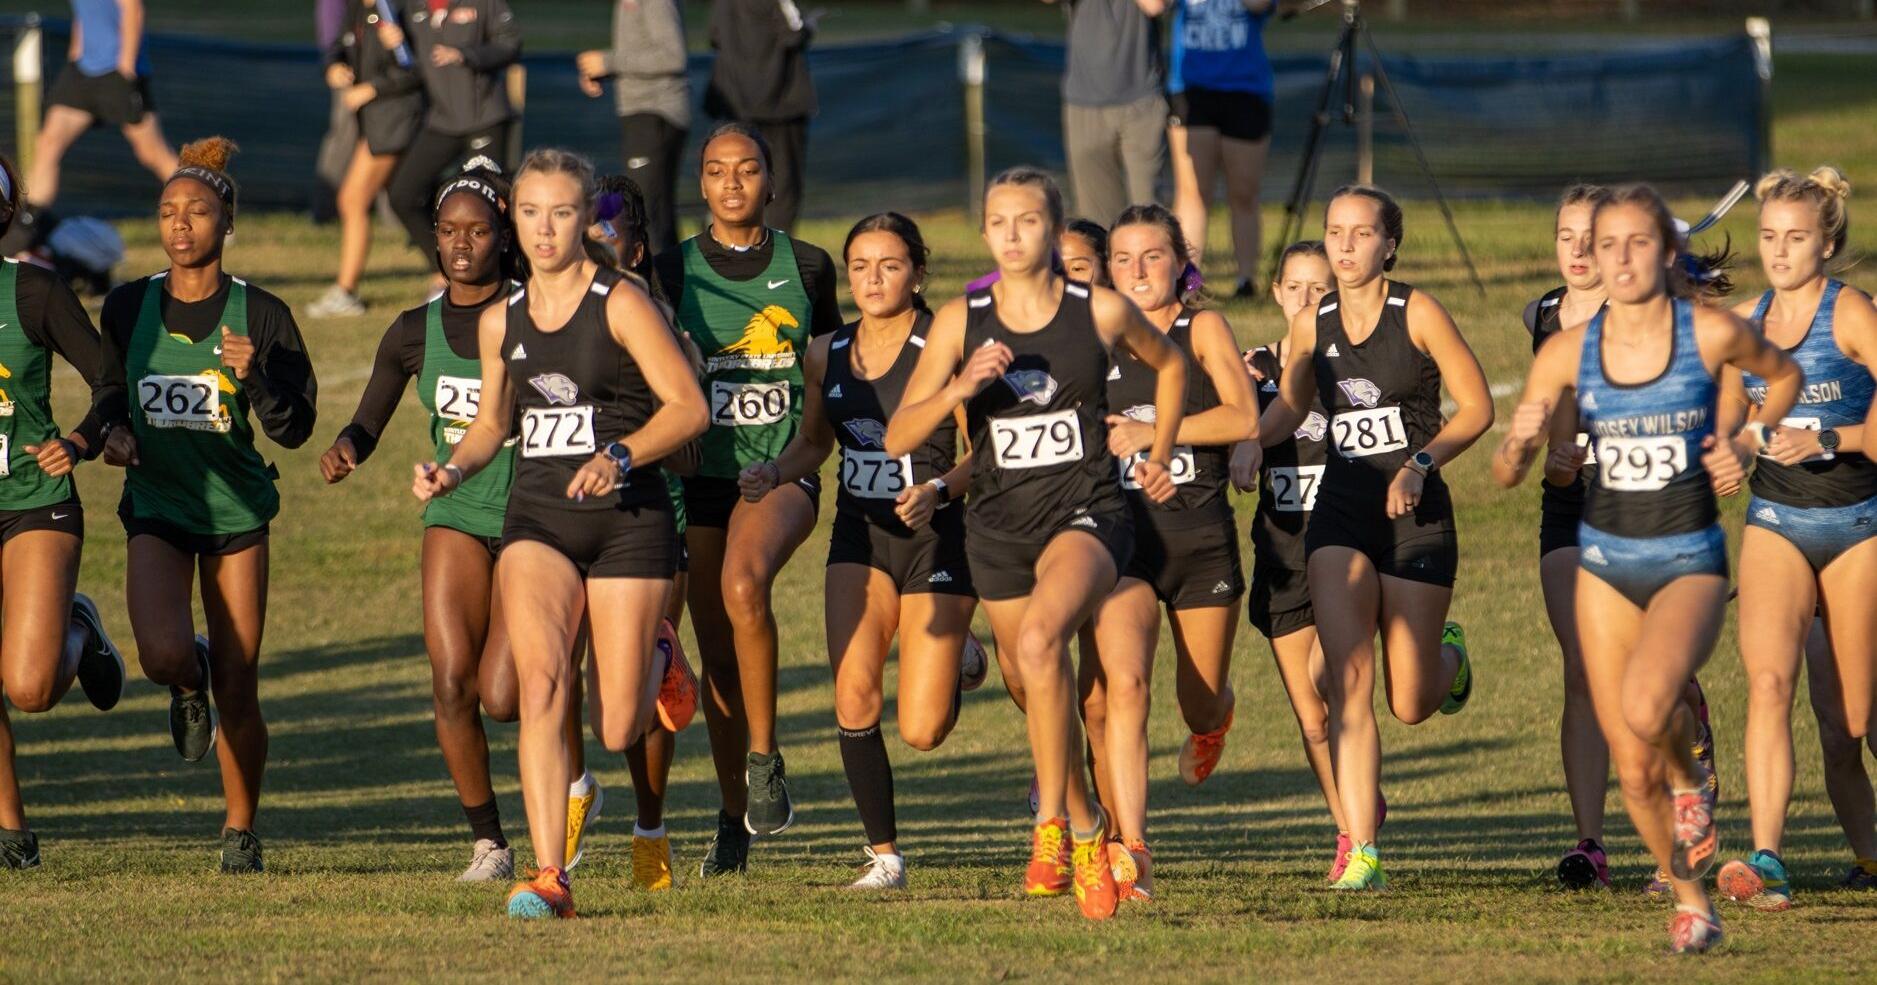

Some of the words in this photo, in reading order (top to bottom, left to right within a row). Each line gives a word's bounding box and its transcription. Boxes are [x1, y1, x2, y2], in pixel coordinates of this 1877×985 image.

[456, 180, 480, 189] DO
[142, 382, 212, 415] 262
[441, 384, 481, 418] 25
[716, 388, 785, 419] 260
[526, 413, 587, 449] 272
[1336, 414, 1401, 452] 281
[1643, 407, 1707, 434] WILSON
[998, 420, 1076, 460] 279
[846, 457, 906, 492] 273
[1606, 445, 1680, 481] 293
[1274, 474, 1316, 506] 27
